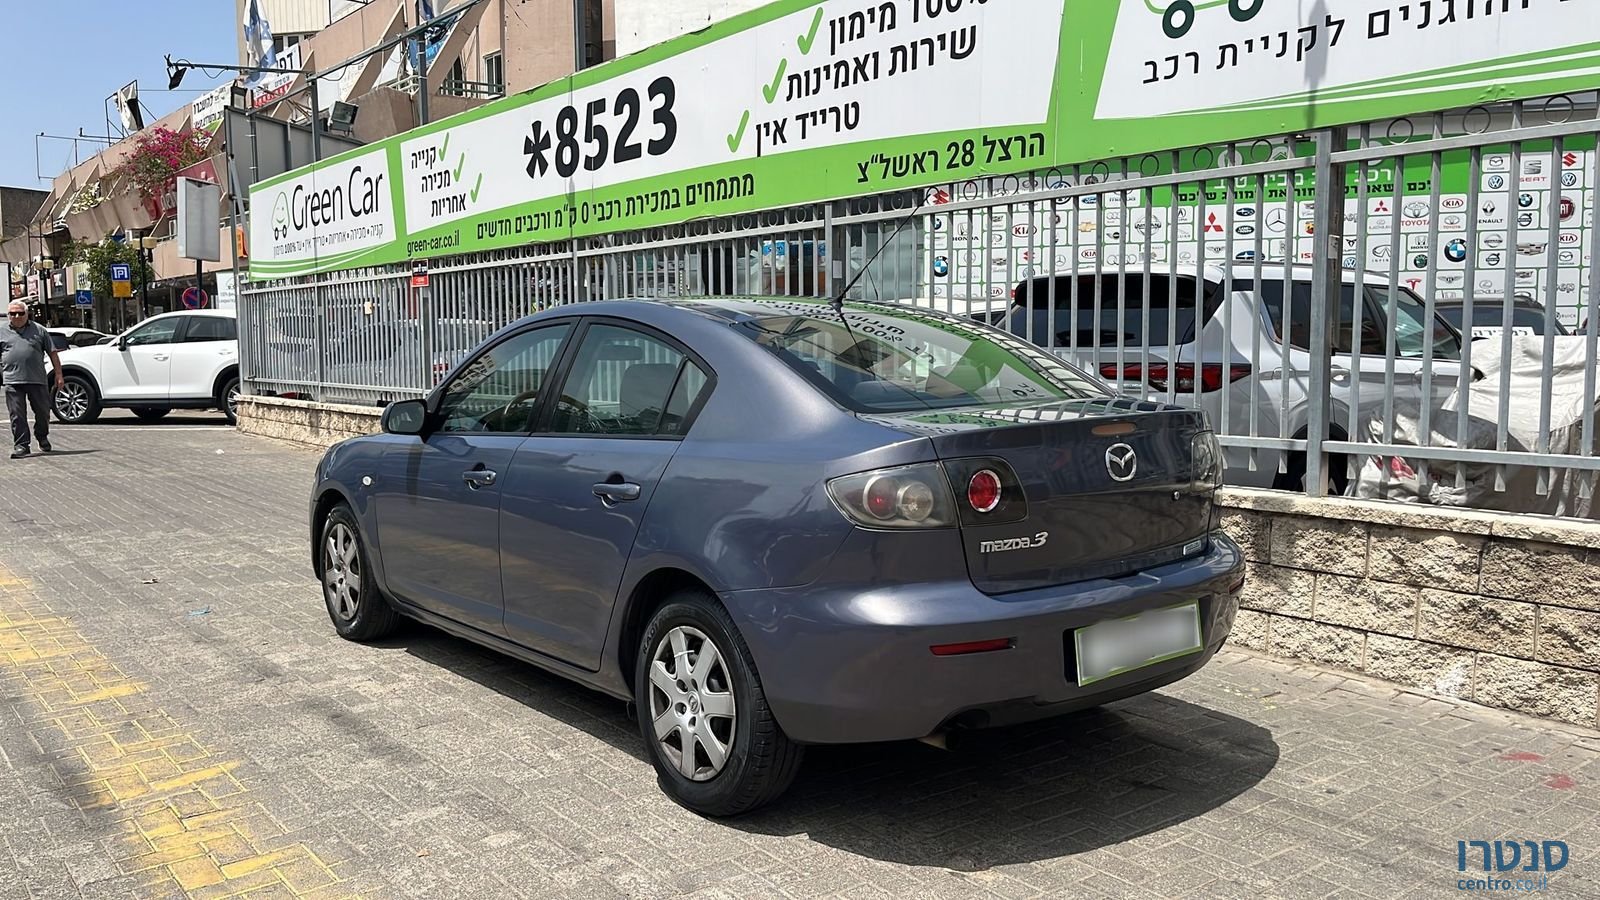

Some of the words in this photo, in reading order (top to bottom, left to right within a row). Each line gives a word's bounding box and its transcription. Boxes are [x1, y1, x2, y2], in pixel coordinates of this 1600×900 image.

[911, 0, 987, 23] 100
[829, 1, 897, 56] מימון
[1216, 14, 1345, 70] לקניית
[888, 25, 977, 77] שירות
[785, 53, 880, 102] ואמינות
[1142, 51, 1200, 84] רכב
[795, 101, 860, 141] טרייד
[755, 118, 787, 158] אין
[982, 132, 1046, 165] הרצל
[411, 147, 436, 170] קנייה
[946, 139, 976, 170] 28
[421, 169, 451, 193] מכירה
[686, 173, 754, 207] מתמחים
[292, 184, 344, 231] Green
[348, 165, 383, 217] Car
[431, 193, 466, 217] אחריות
[592, 199, 621, 222] רכבי
[625, 187, 681, 217] במכירת
[1179, 191, 1216, 202] שכם
[477, 218, 512, 240] חדשים
[515, 212, 550, 234] ורכבים
[581, 205, 589, 224] 0
[407, 229, 460, 257] green-car.co.il
